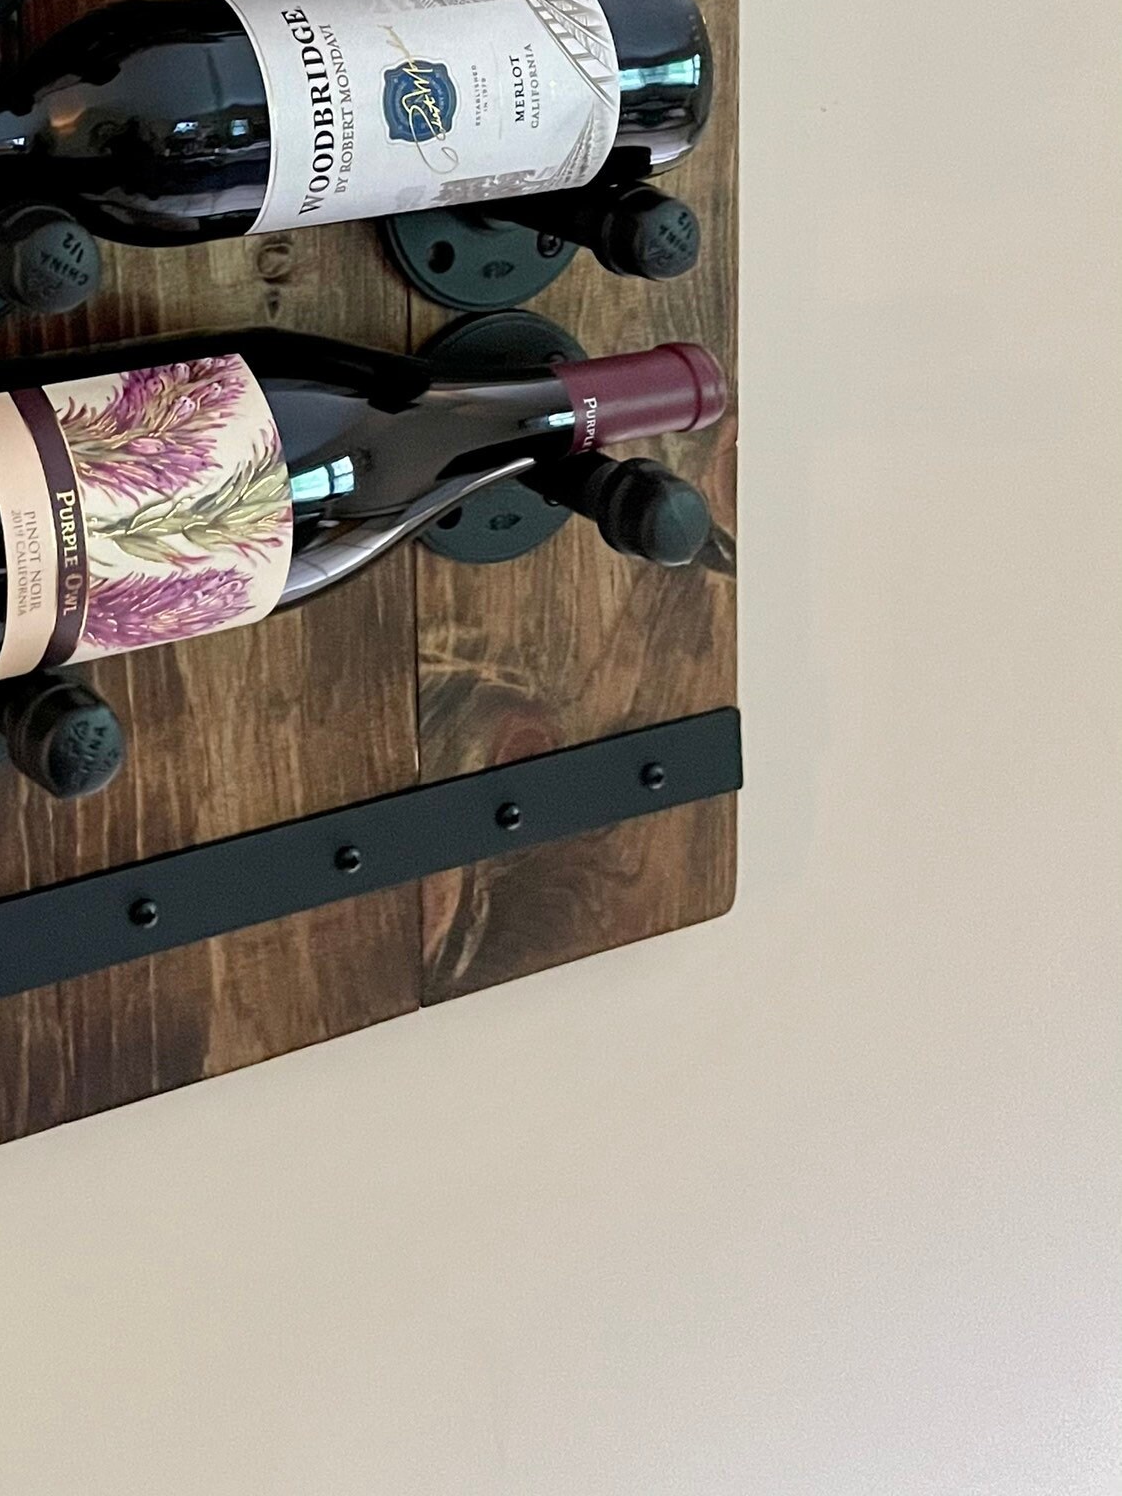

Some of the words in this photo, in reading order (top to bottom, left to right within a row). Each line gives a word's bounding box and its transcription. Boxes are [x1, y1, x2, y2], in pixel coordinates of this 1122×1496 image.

[319, 24, 353, 104] MONDAVI
[471, 64, 481, 126] ESTABLISHED
[509, 55, 525, 123] MERLOT
[524, 43, 540, 129] CALIFORNIA
[281, 8, 335, 216] WOODBRIDGE
[340, 108, 354, 173] ROBERT
[335, 177, 349, 194] BY
[40, 250, 89, 286] CHINA
[62, 232, 84, 264] 1/2
[24, 510, 41, 564] PINOT
[56, 489, 78, 568] PURPLE
[15, 540, 28, 616] CALIFORNIA
[29, 570, 42, 612] NOIR
[63, 573, 83, 616] OWL
